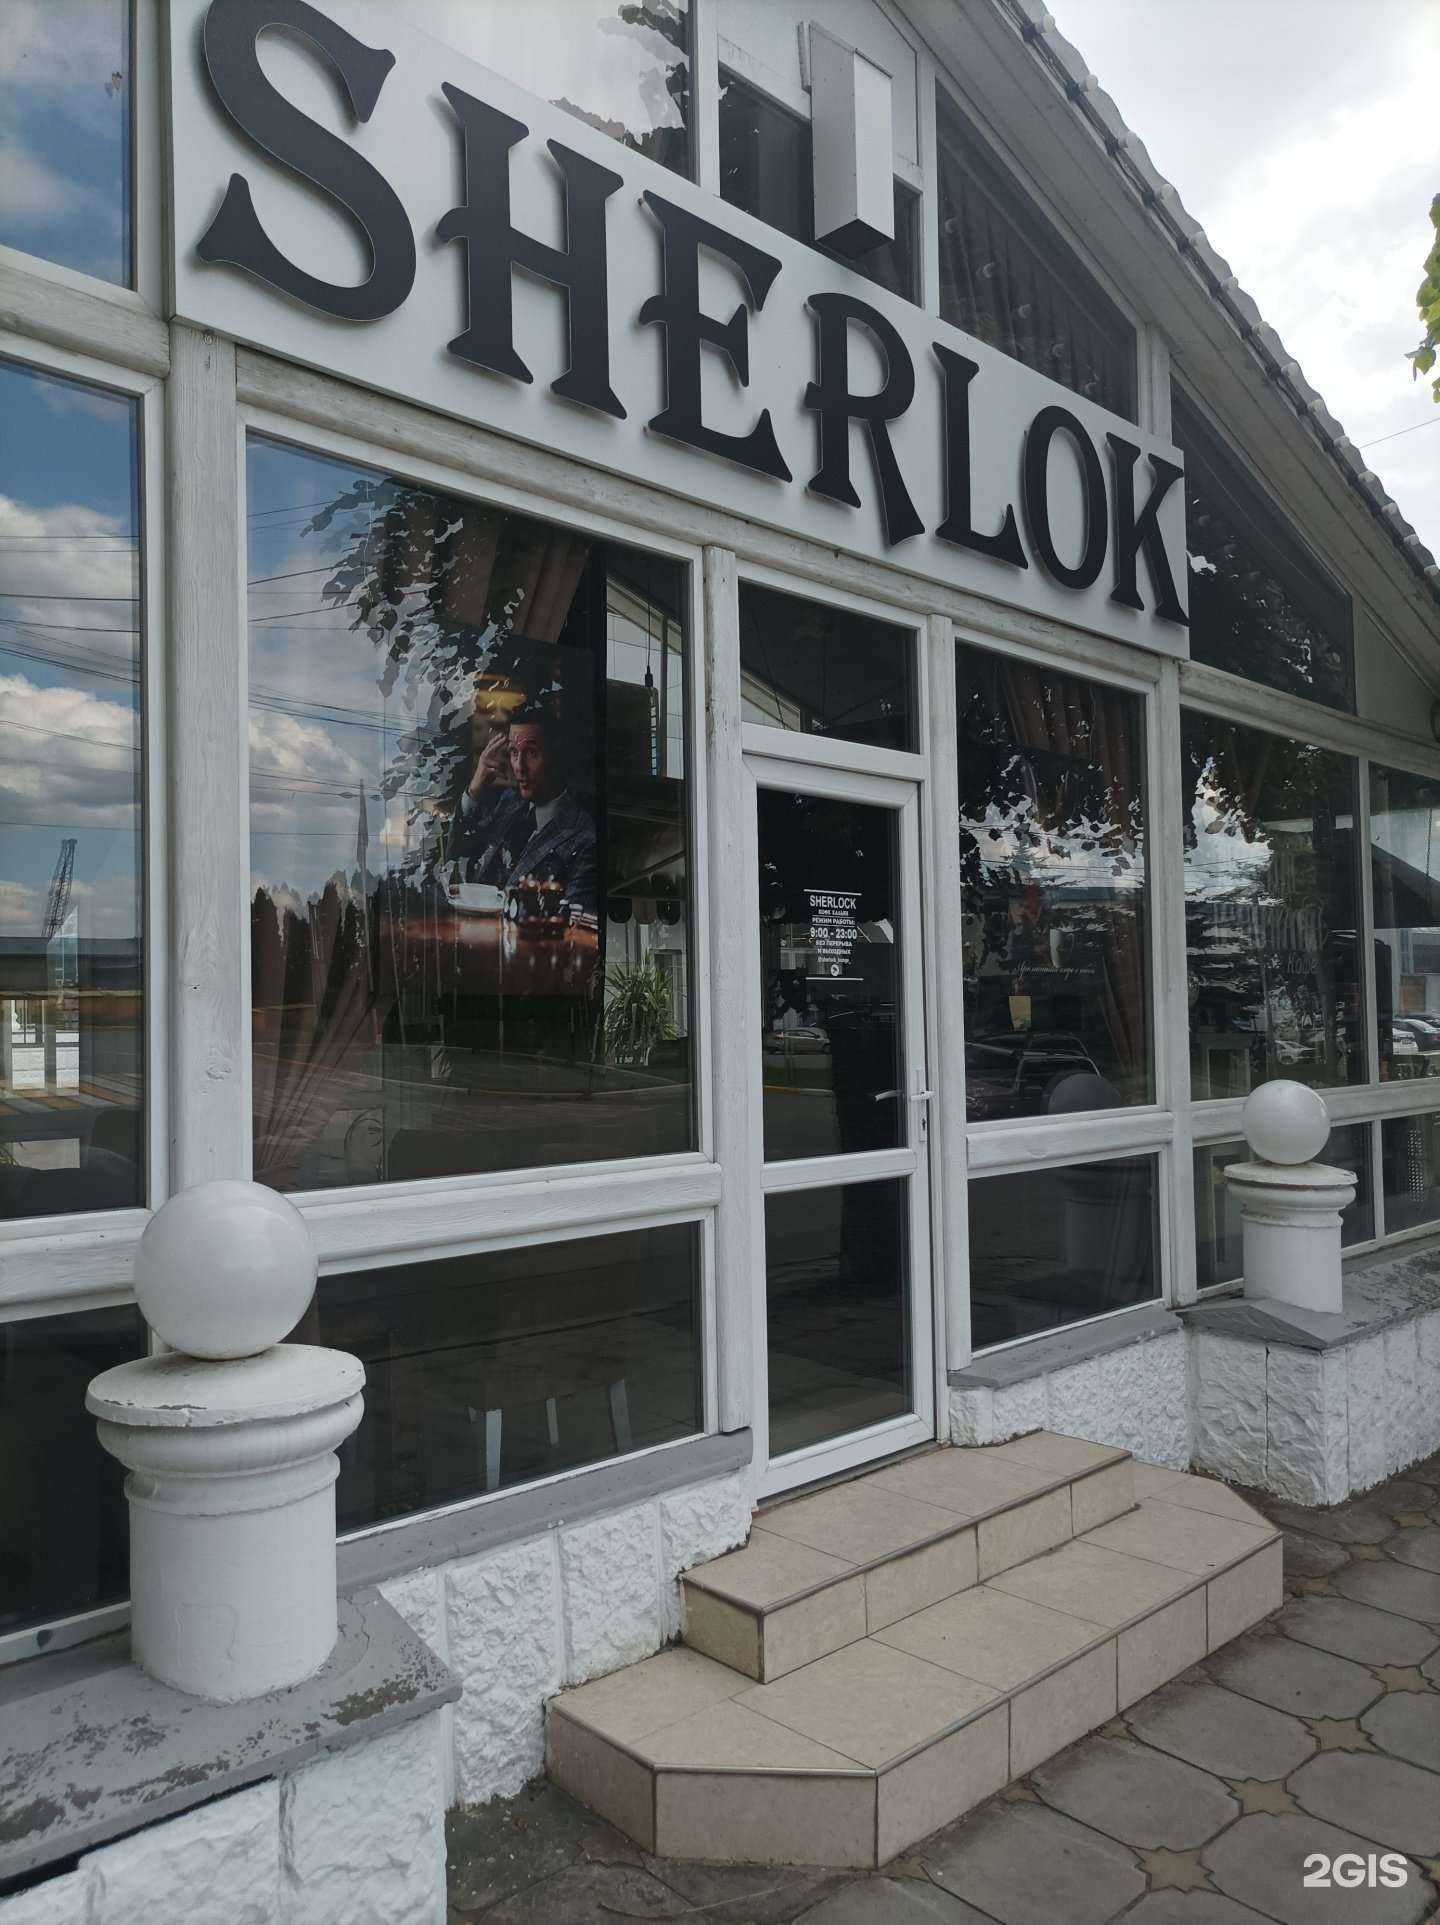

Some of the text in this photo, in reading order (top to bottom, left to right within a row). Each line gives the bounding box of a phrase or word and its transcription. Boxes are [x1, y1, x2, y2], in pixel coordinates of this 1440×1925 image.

[197, 0, 1189, 627] SHERLOK
[809, 894, 857, 910] SHERLOCK
[835, 928, 858, 939] 23:00
